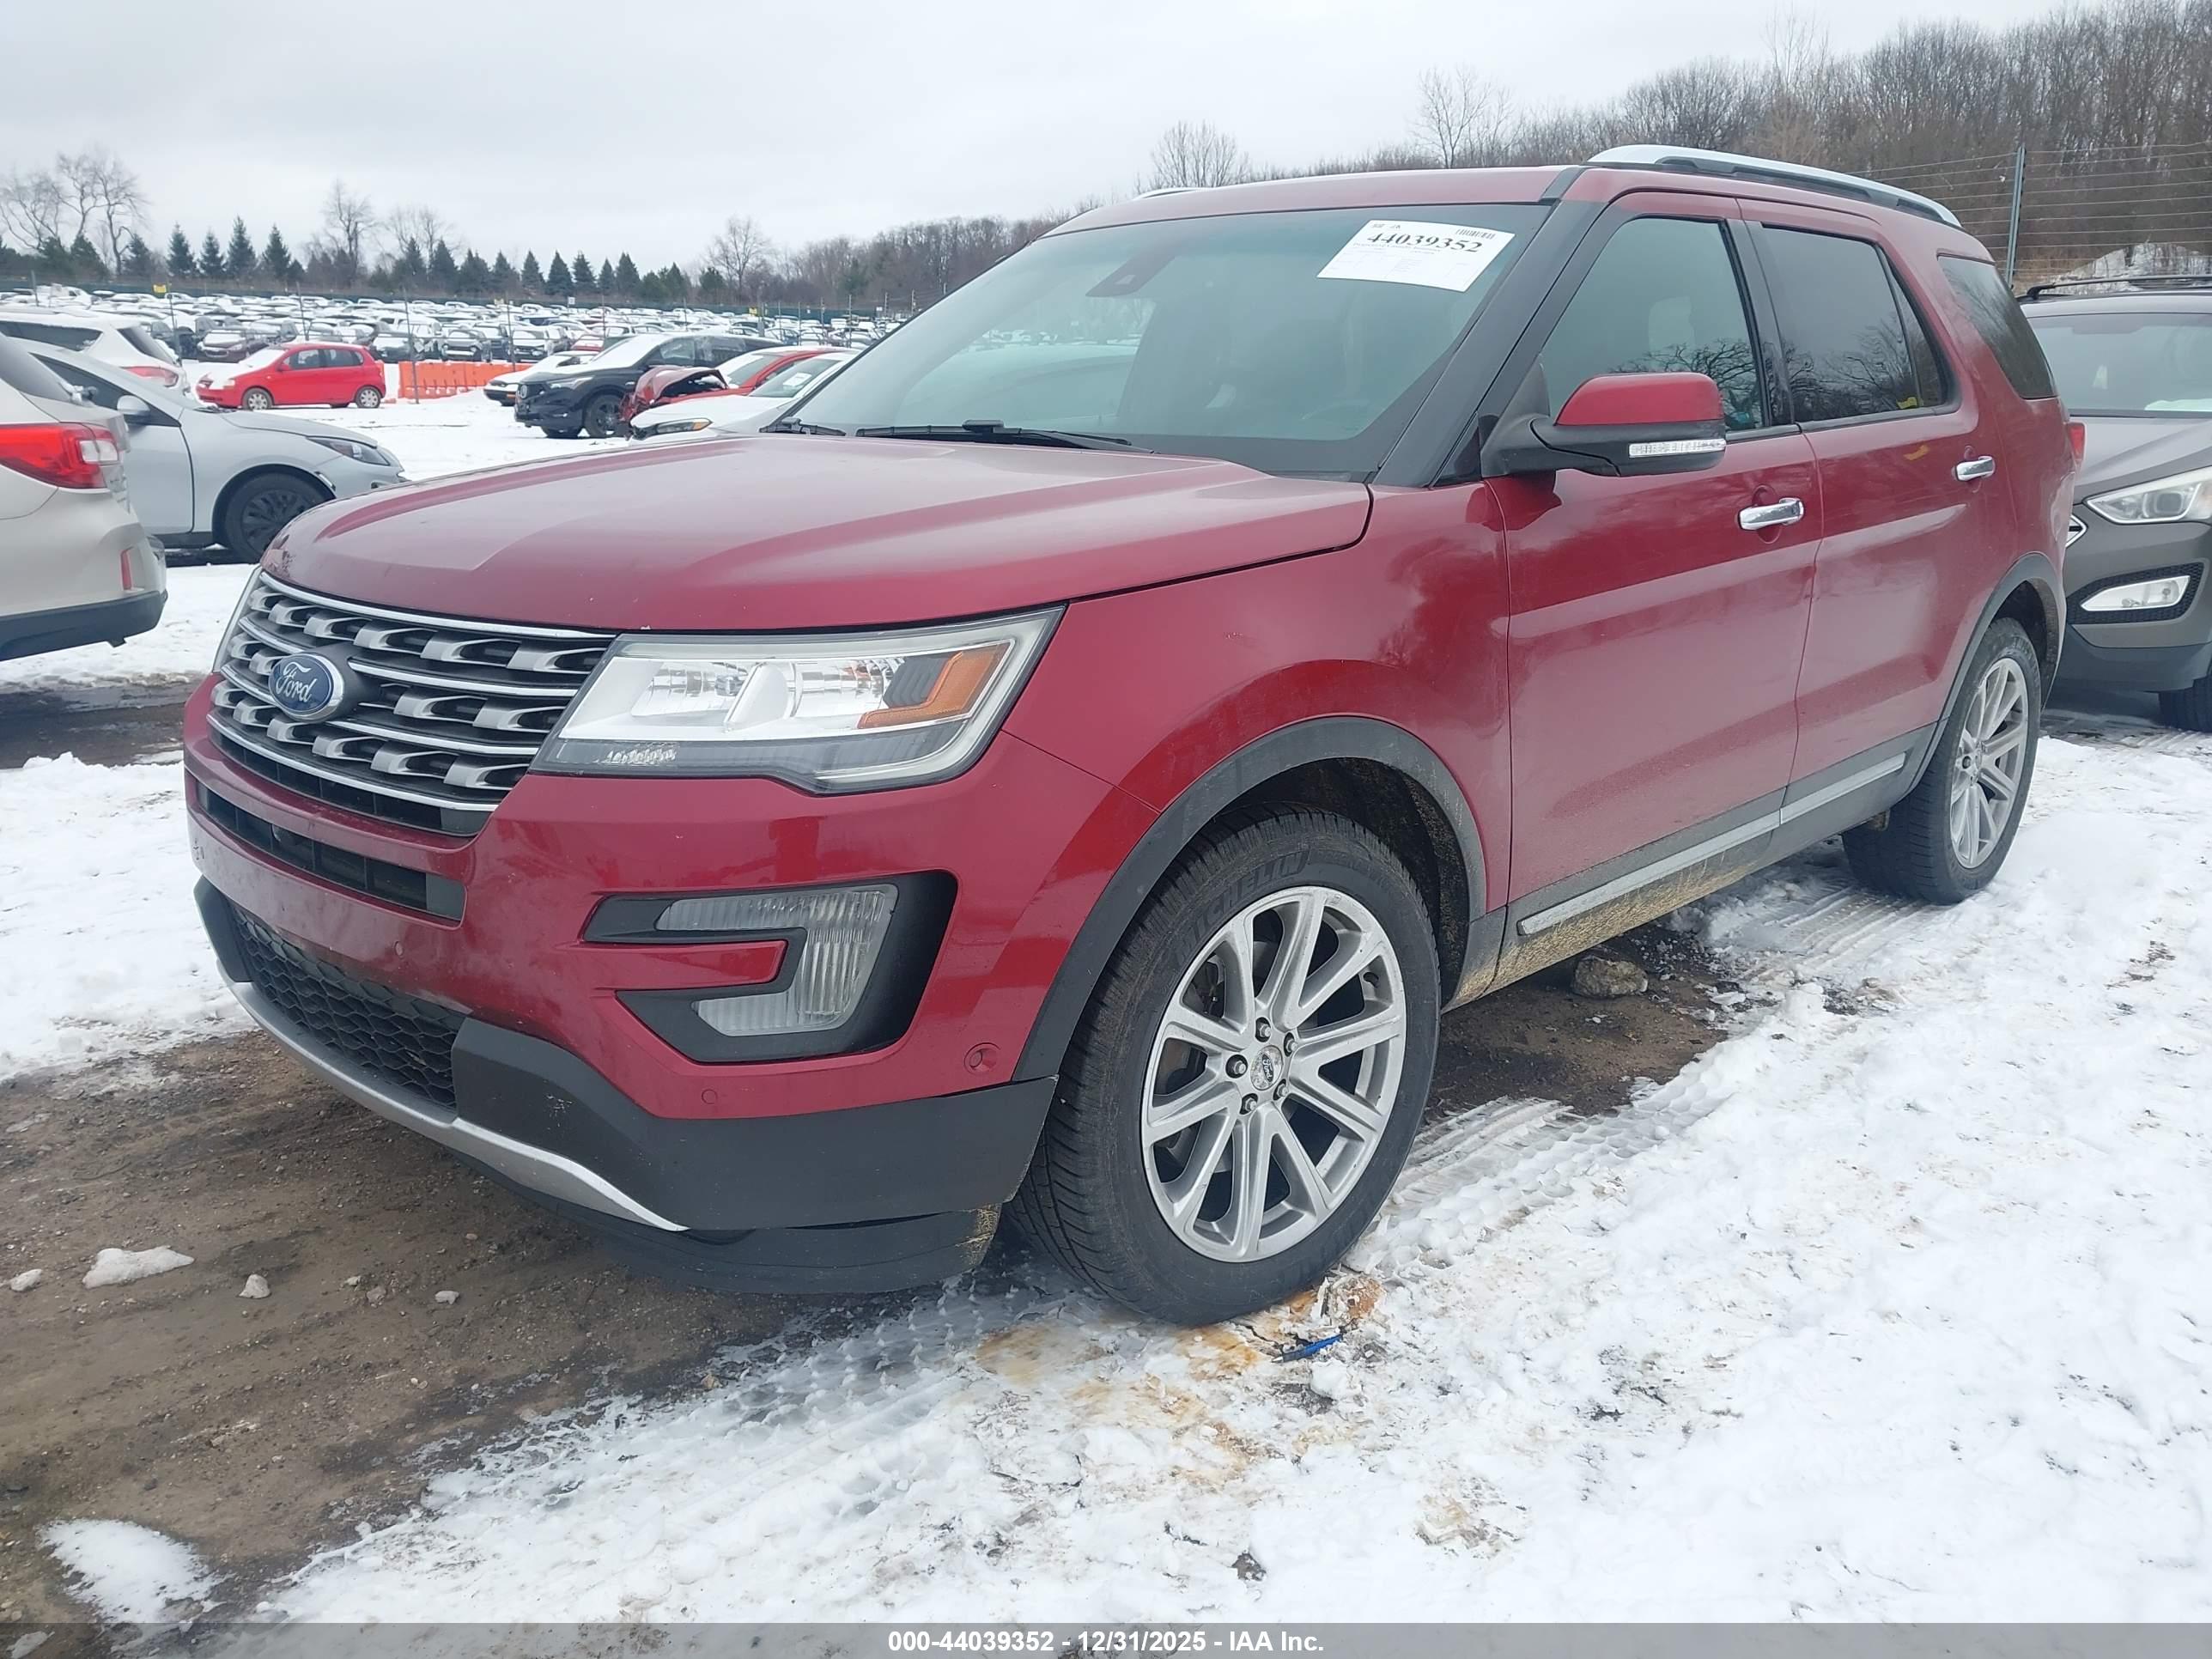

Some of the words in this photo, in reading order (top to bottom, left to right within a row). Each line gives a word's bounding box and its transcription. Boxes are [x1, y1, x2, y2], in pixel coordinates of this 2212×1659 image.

[1366, 232, 1483, 253] 44039352
[276, 660, 319, 703] Ford
[1174, 850, 1310, 969] MICHELIN
